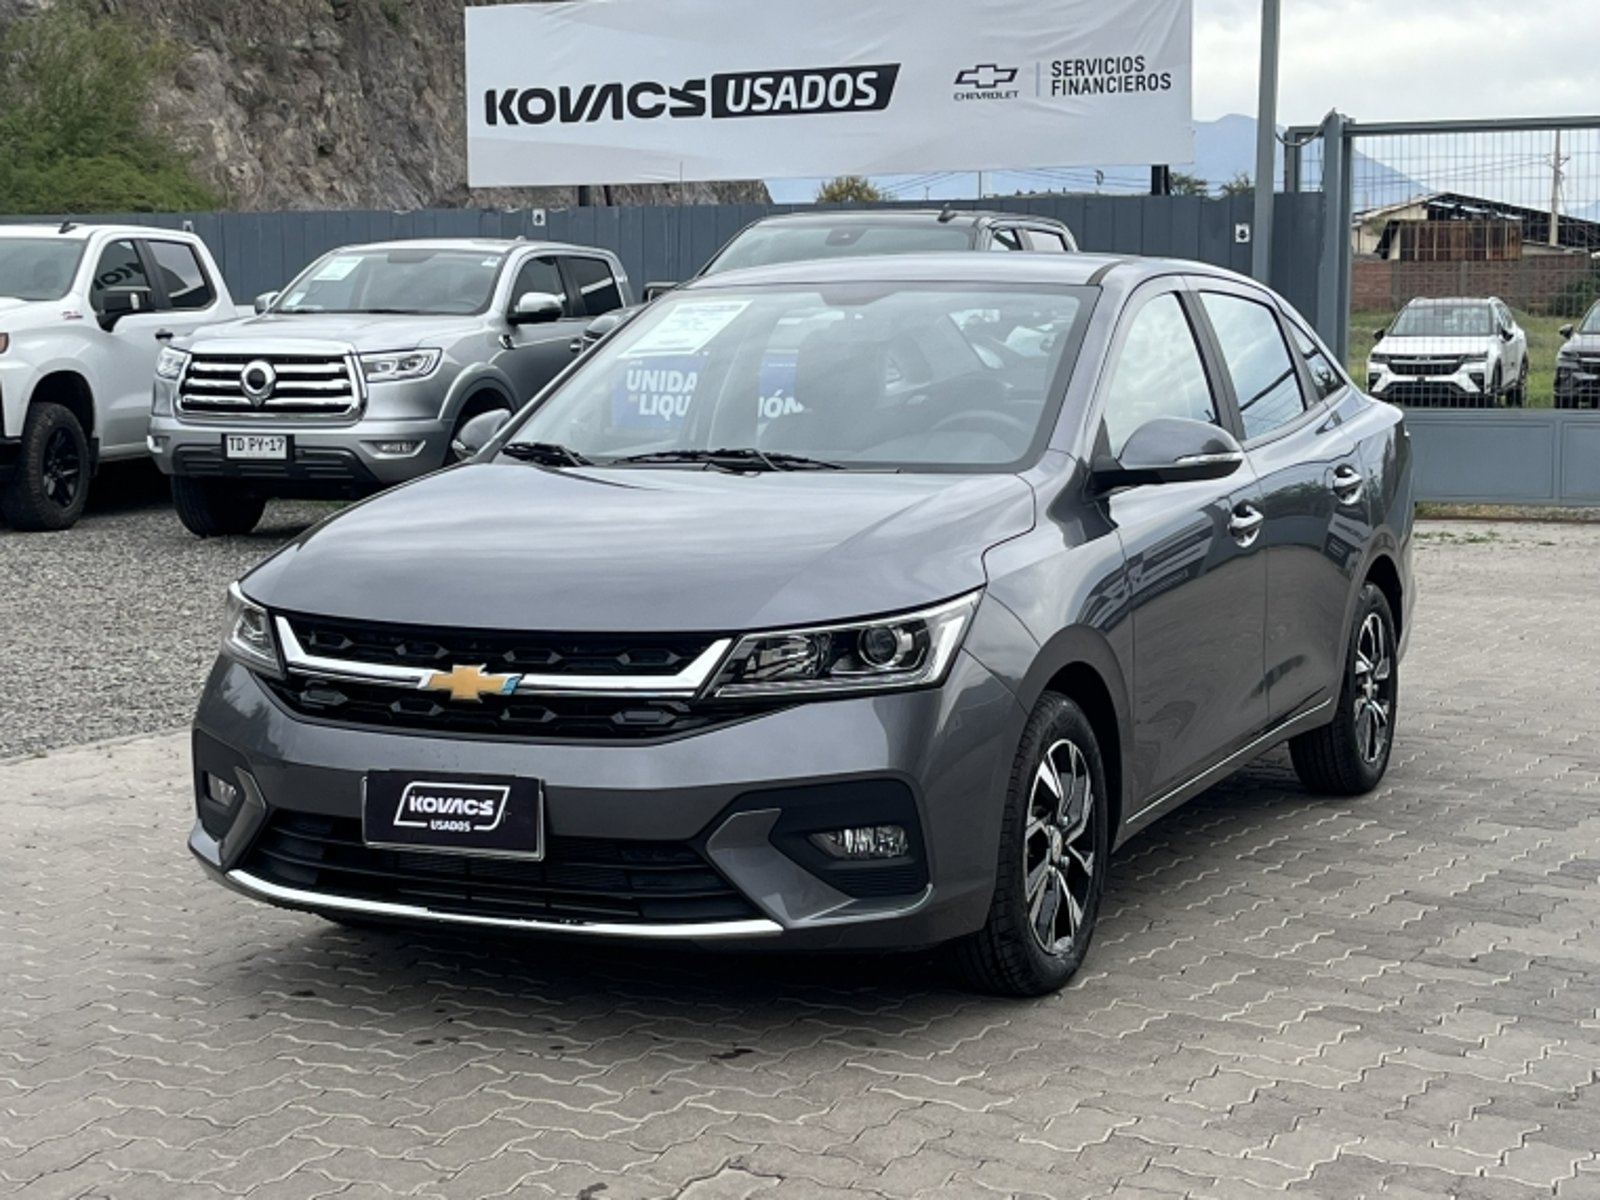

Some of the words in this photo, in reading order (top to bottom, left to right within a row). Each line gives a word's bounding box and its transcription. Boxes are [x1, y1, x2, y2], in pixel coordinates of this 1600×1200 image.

[1051, 56, 1146, 77] SERVICIOS
[1051, 73, 1172, 96] FINANCIEROS
[485, 79, 706, 126] KOVACS
[726, 71, 878, 113] USADOS
[954, 90, 1019, 101] CHEVROLET
[409, 796, 494, 816] KOVACS
[430, 819, 470, 832] USADOS
